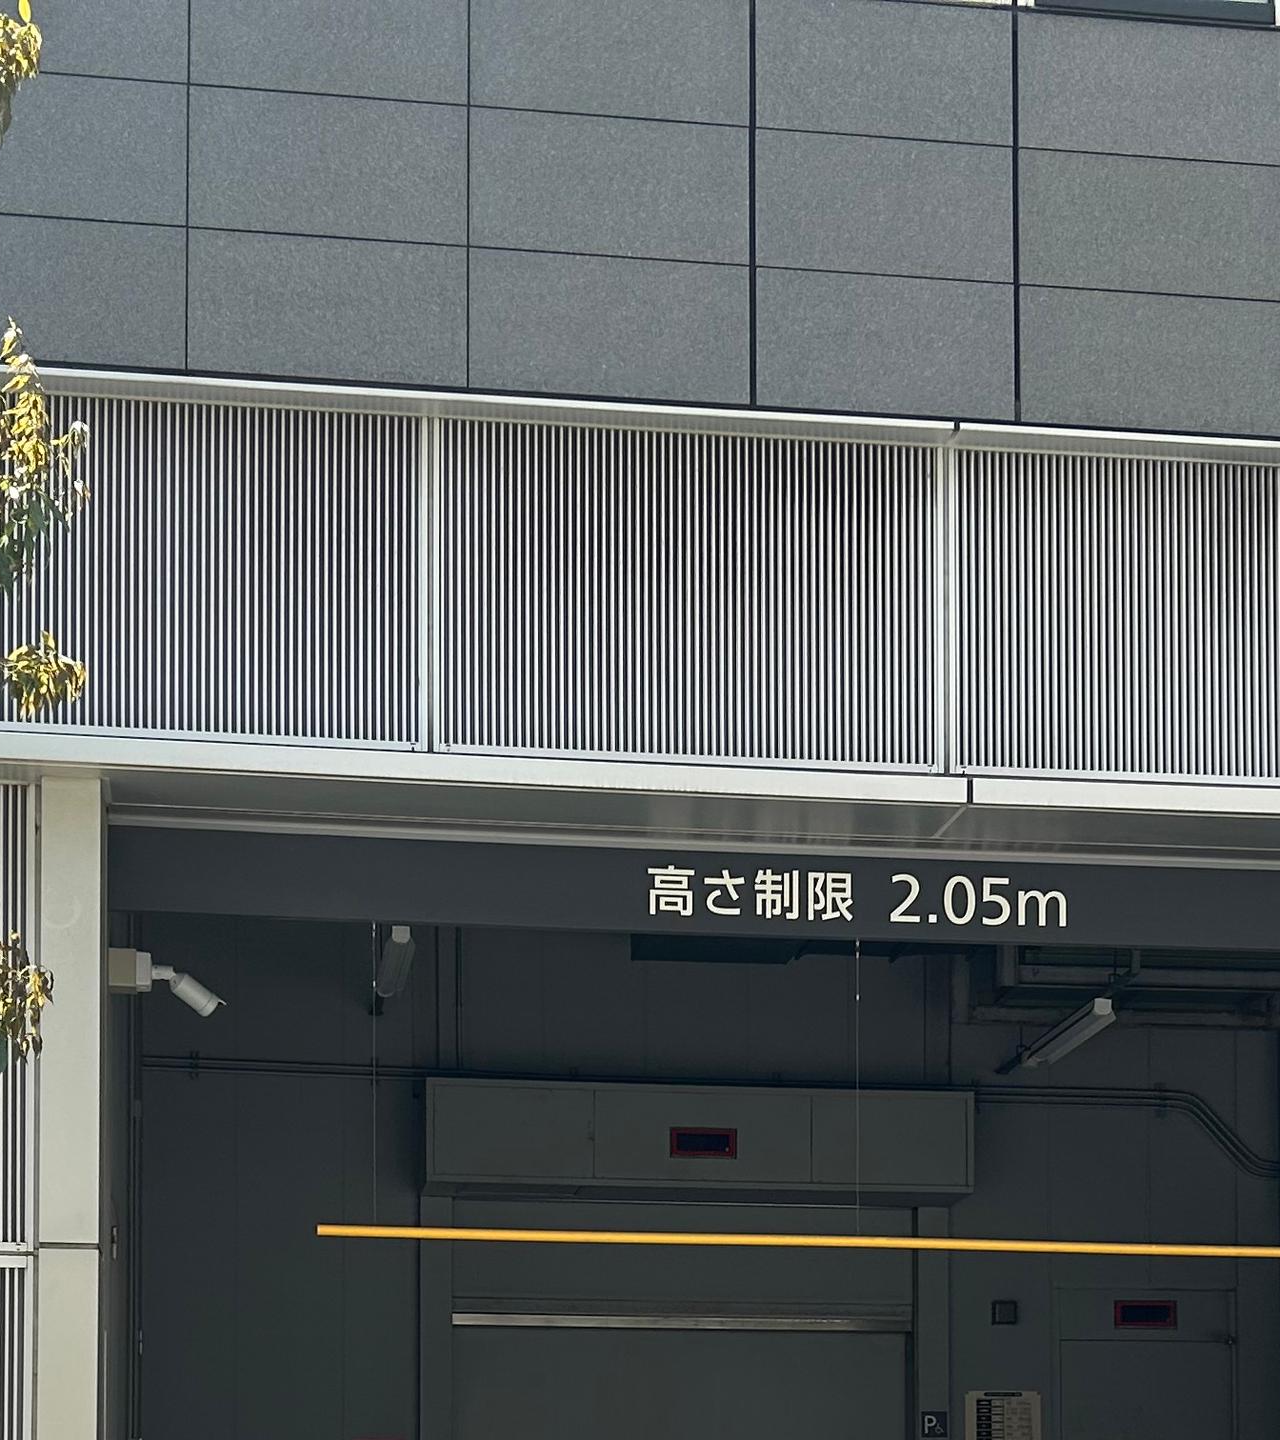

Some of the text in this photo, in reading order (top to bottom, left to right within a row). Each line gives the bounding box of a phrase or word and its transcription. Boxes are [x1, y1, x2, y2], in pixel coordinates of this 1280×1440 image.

[647, 864, 1068, 928] 高さ制限 2.05m
[924, 1415, 937, 1434] P
